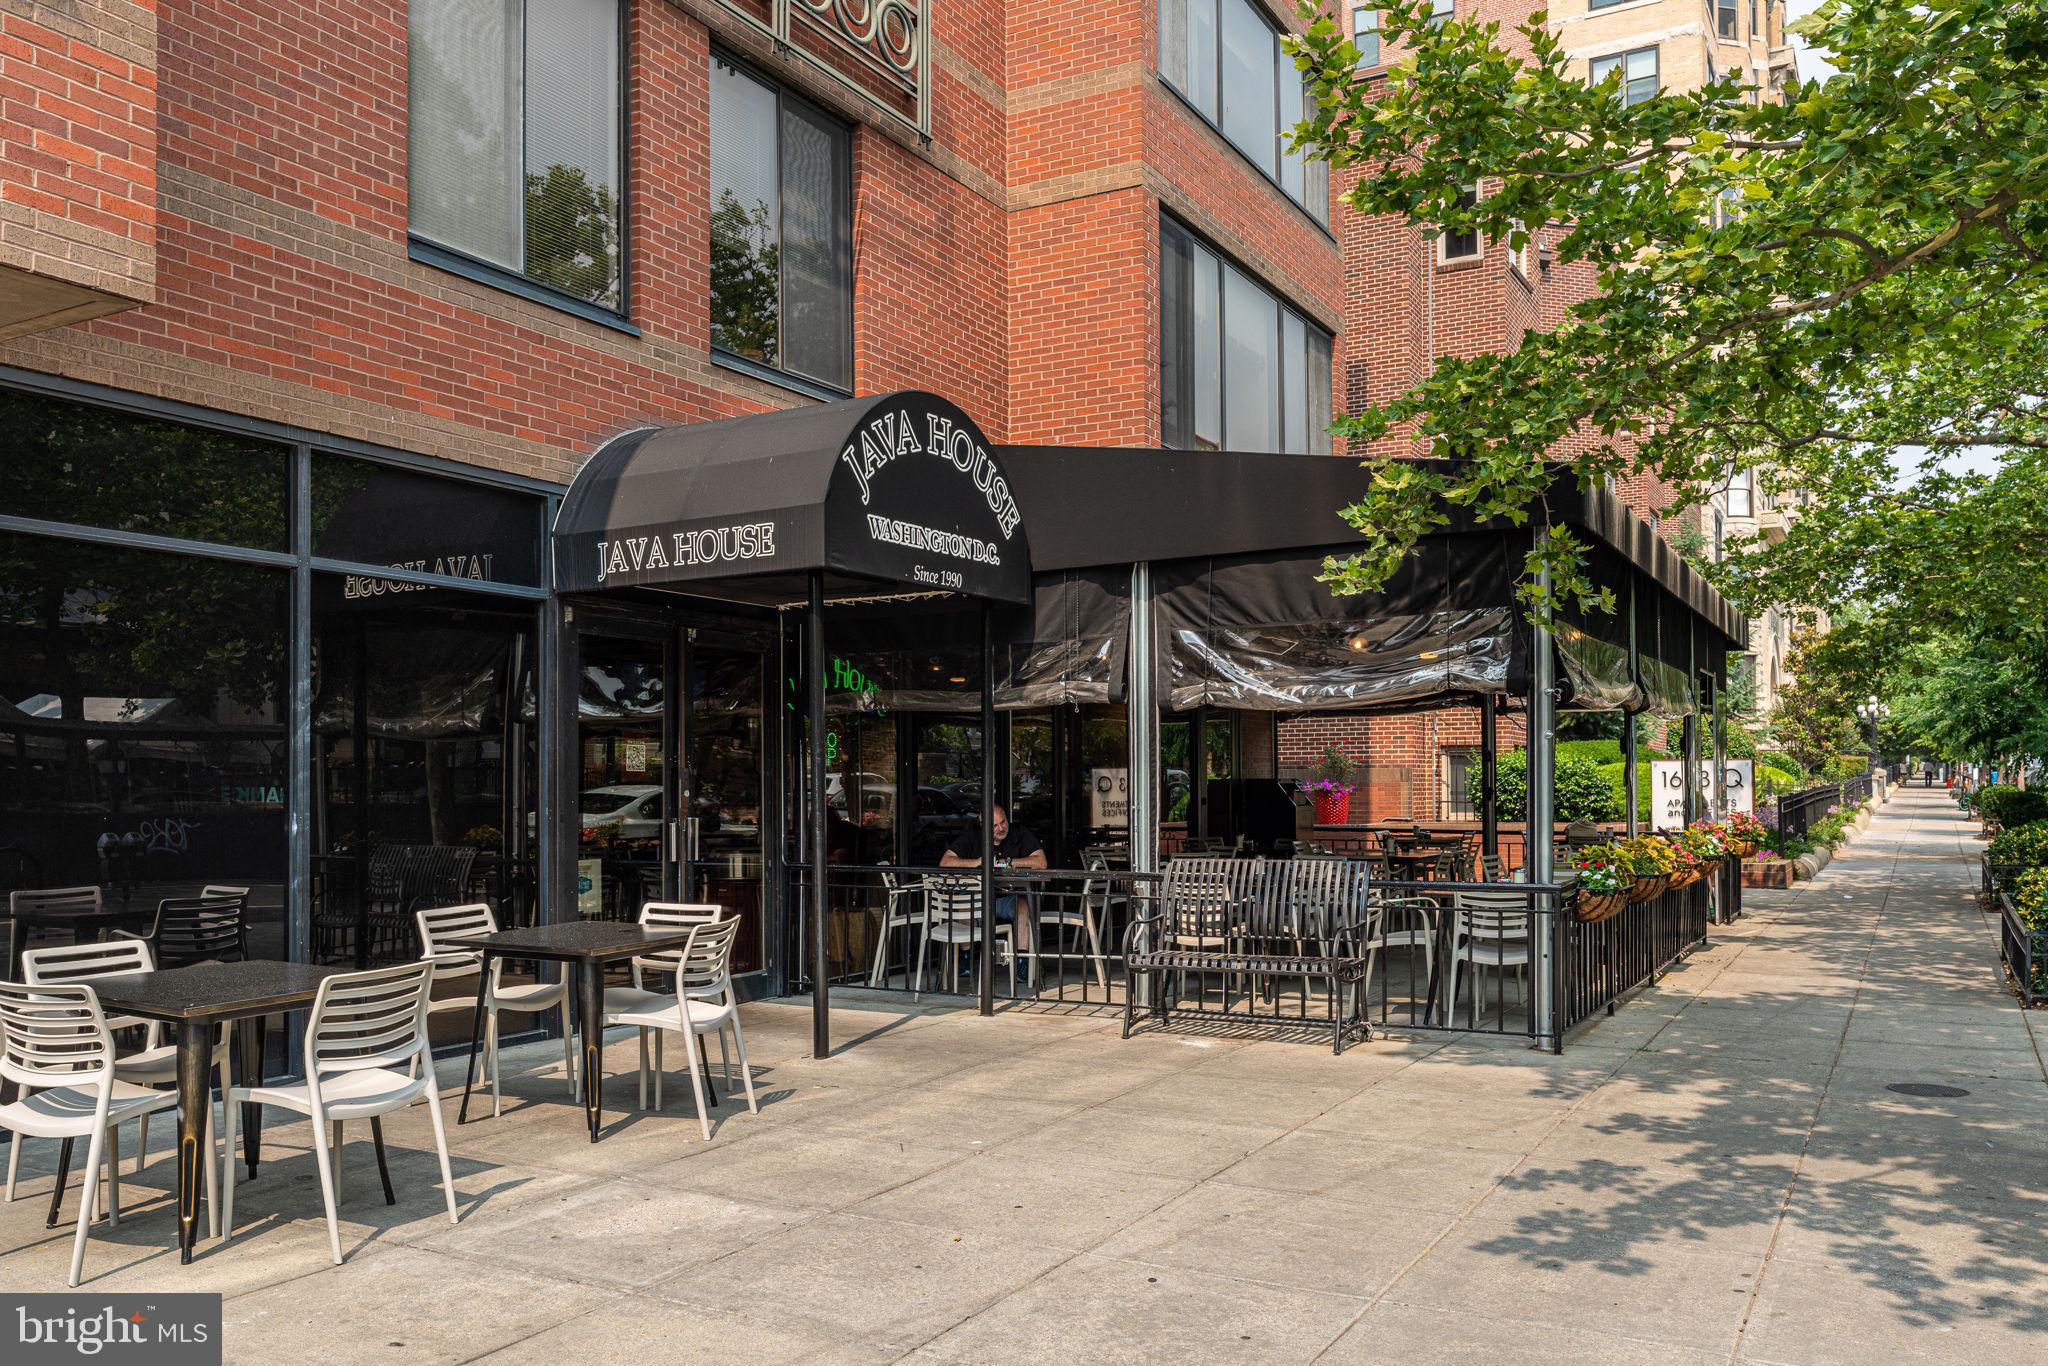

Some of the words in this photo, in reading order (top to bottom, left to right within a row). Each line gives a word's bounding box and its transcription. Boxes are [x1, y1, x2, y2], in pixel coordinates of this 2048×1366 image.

[842, 409, 922, 505] JAVA
[926, 412, 1021, 540] HOUSE
[597, 535, 669, 582] JAVA
[673, 522, 775, 567] HOUSE
[867, 514, 972, 559] WASHINGTON
[973, 539, 1001, 566] D.C.
[913, 564, 939, 584] Since
[940, 570, 963, 588] 1990
[1661, 771, 1710, 788] 163
[1726, 768, 1744, 788] Q
